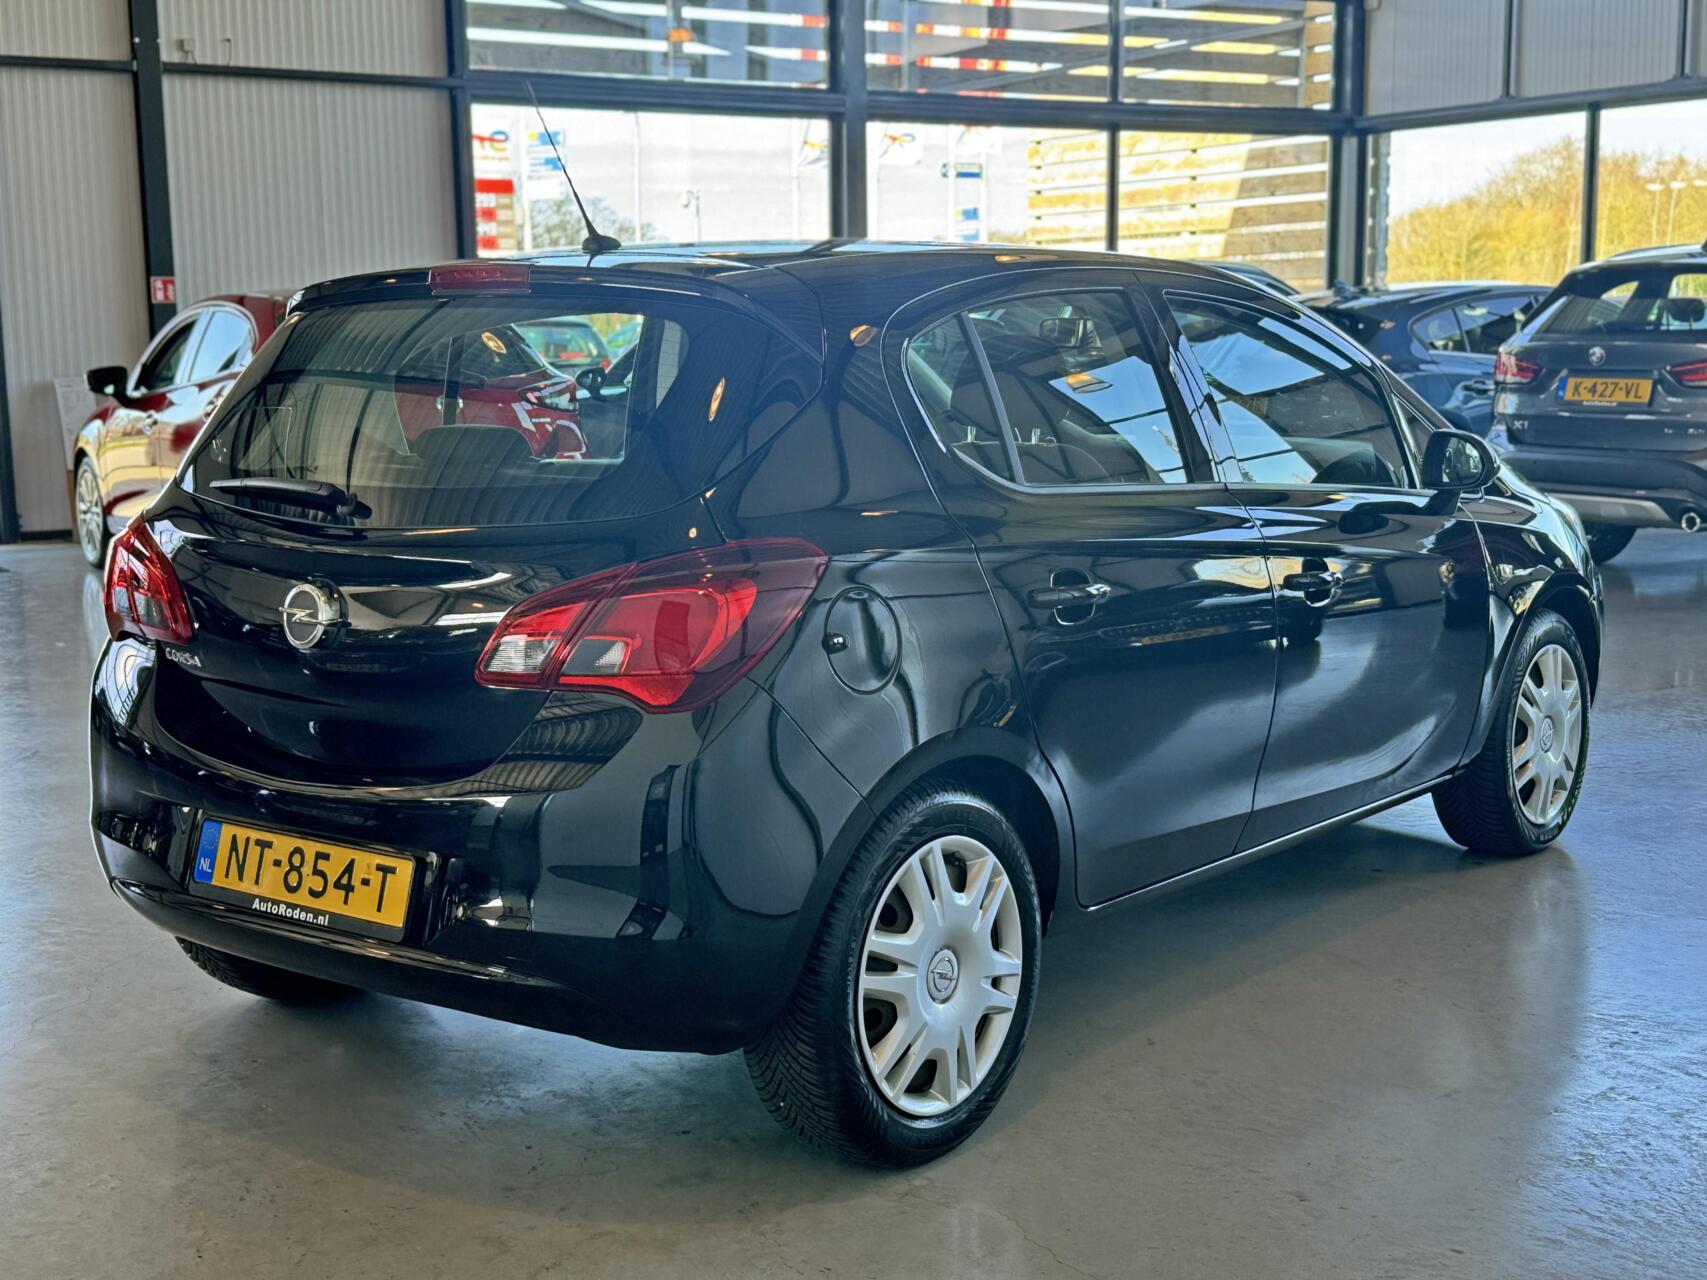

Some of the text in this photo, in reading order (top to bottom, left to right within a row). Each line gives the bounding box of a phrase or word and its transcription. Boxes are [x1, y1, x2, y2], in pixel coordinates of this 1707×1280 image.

[1571, 381, 1642, 399] K-427-VL
[165, 647, 202, 667] CORSA
[199, 860, 212, 873] NL
[224, 833, 397, 913] NT-854-T
[252, 897, 329, 926] AutoRoden.nl
